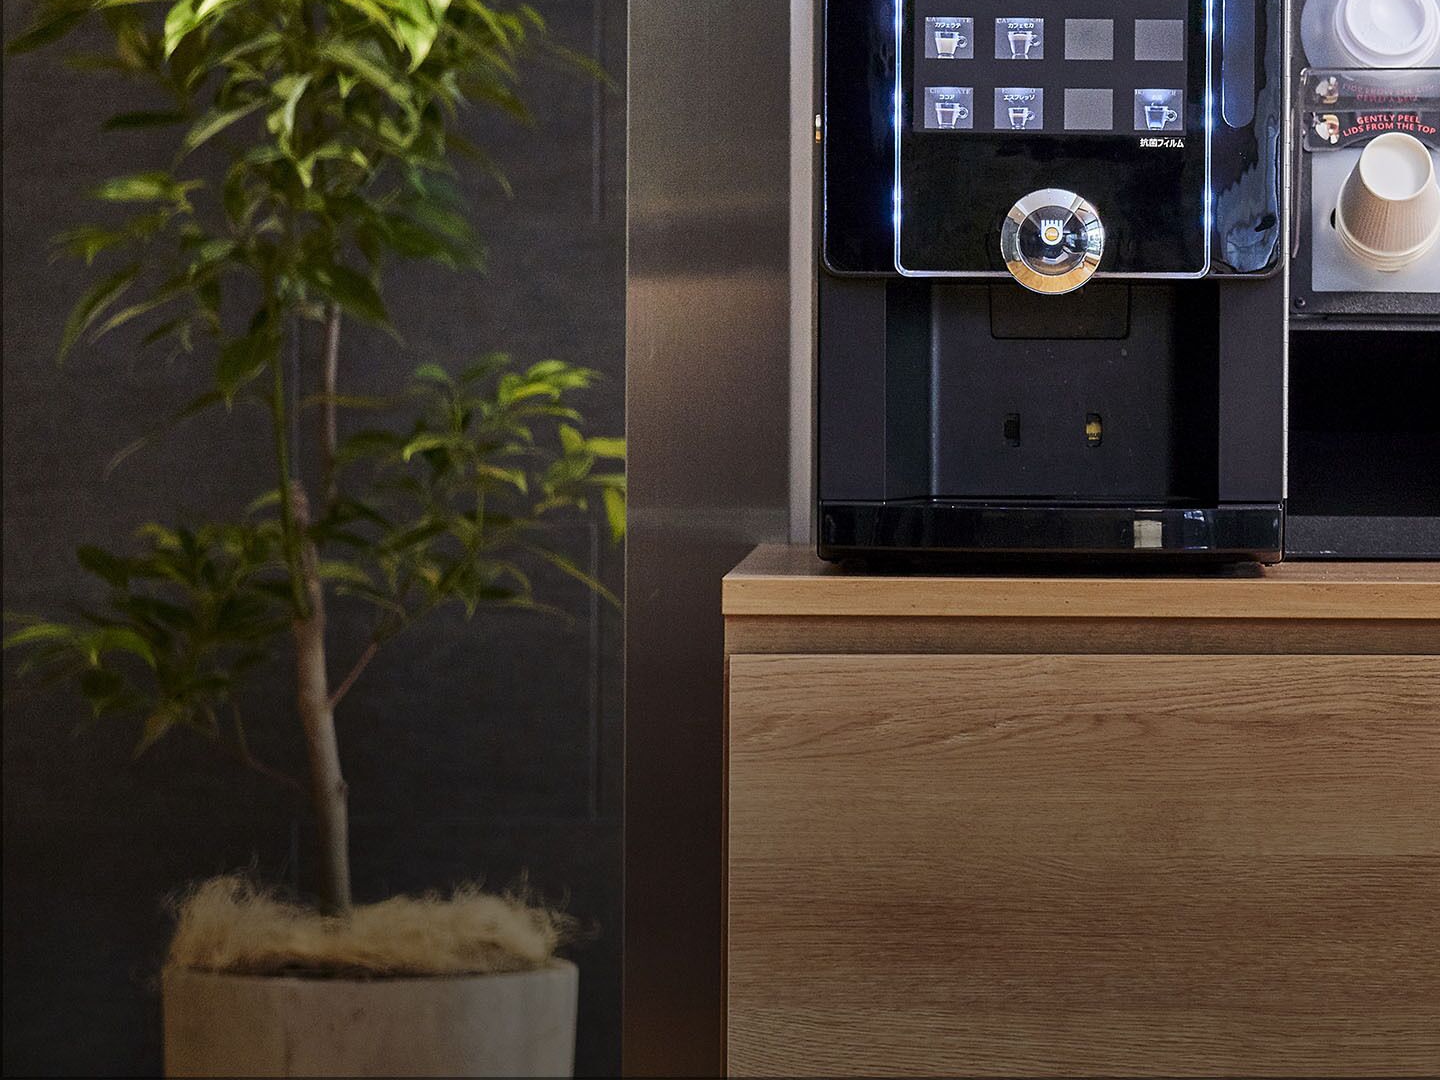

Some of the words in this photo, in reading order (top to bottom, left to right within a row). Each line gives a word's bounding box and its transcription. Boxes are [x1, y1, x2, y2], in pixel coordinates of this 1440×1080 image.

[1356, 114, 1395, 124] GENTLY
[1398, 114, 1421, 124] PEEL
[1342, 126, 1364, 137] LIDS
[1366, 122, 1394, 131] FROM
[1397, 122, 1414, 131] THE
[1417, 124, 1436, 134] TOP
[1140, 138, 1184, 148] 抗菌フィルム
